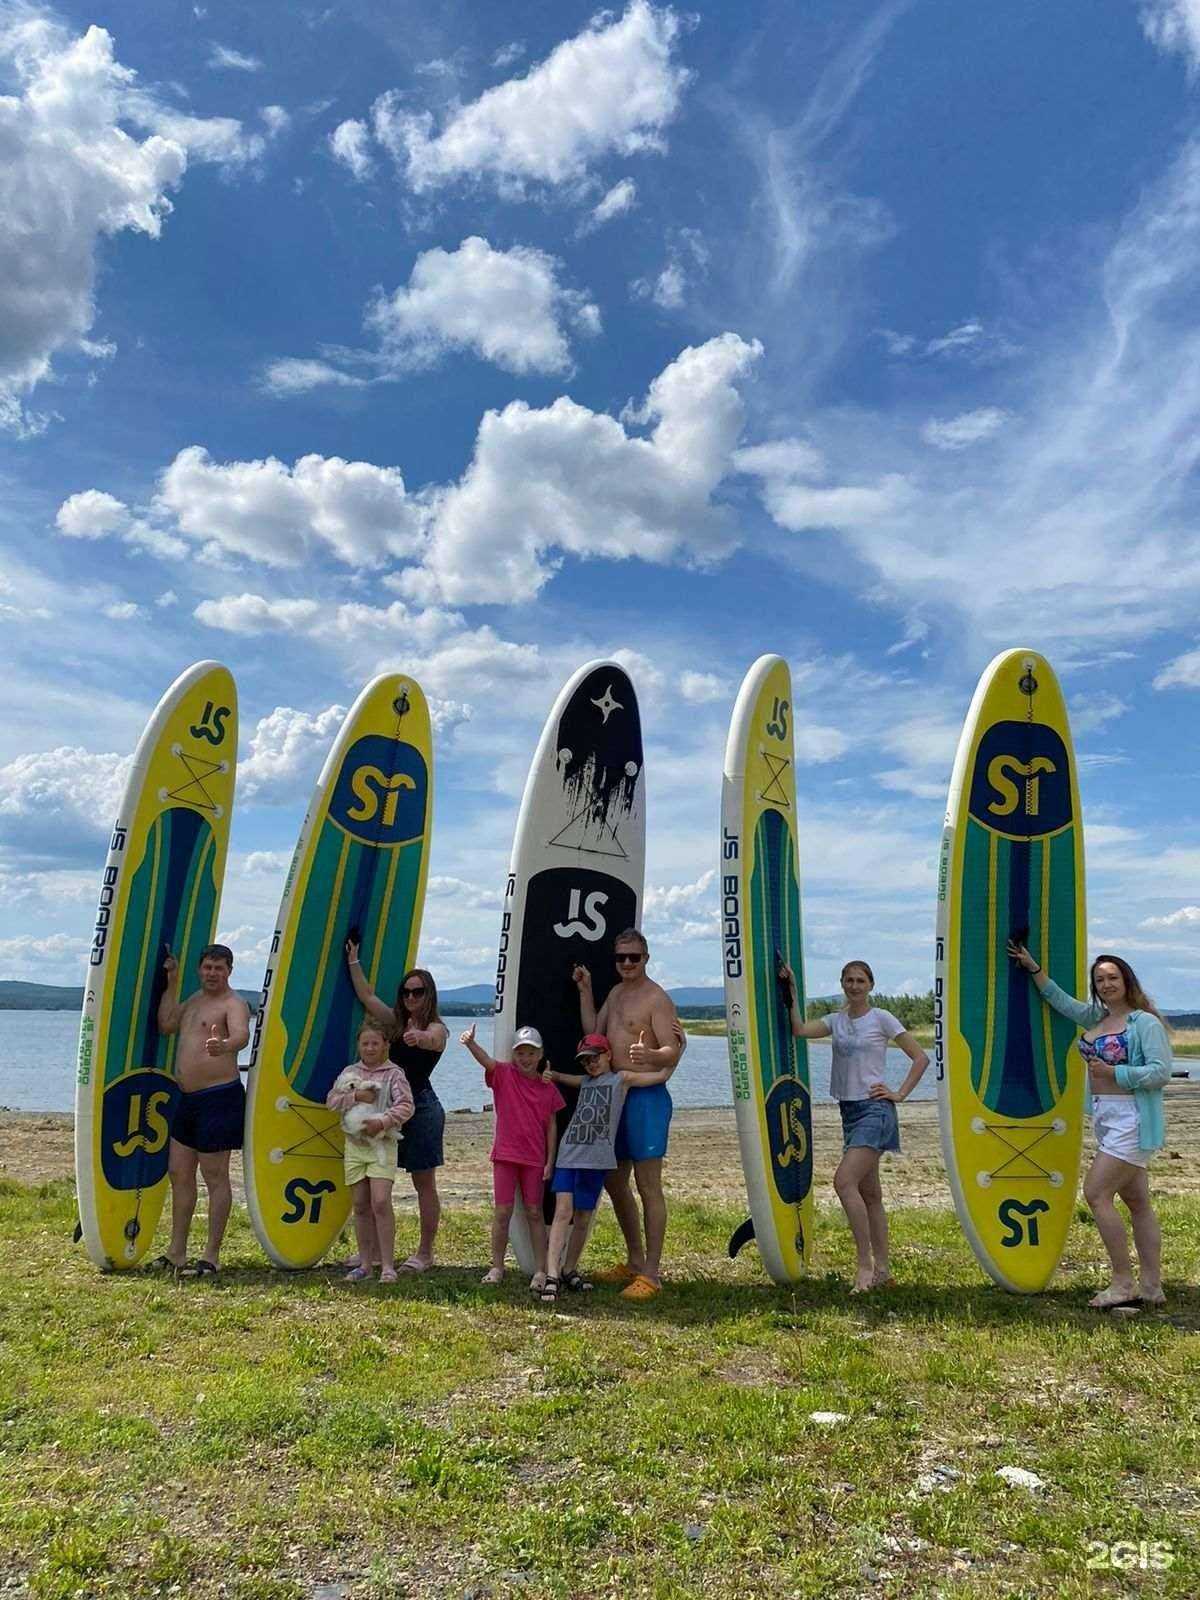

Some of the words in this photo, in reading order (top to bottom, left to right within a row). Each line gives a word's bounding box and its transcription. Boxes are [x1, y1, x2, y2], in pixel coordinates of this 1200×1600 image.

[190, 701, 231, 746] JS
[110, 819, 127, 851] JS
[724, 827, 739, 860] JS
[89, 866, 118, 966] BOARD
[553, 888, 609, 942] JS
[724, 875, 742, 978] BOARD
[113, 1092, 170, 1157] JS
